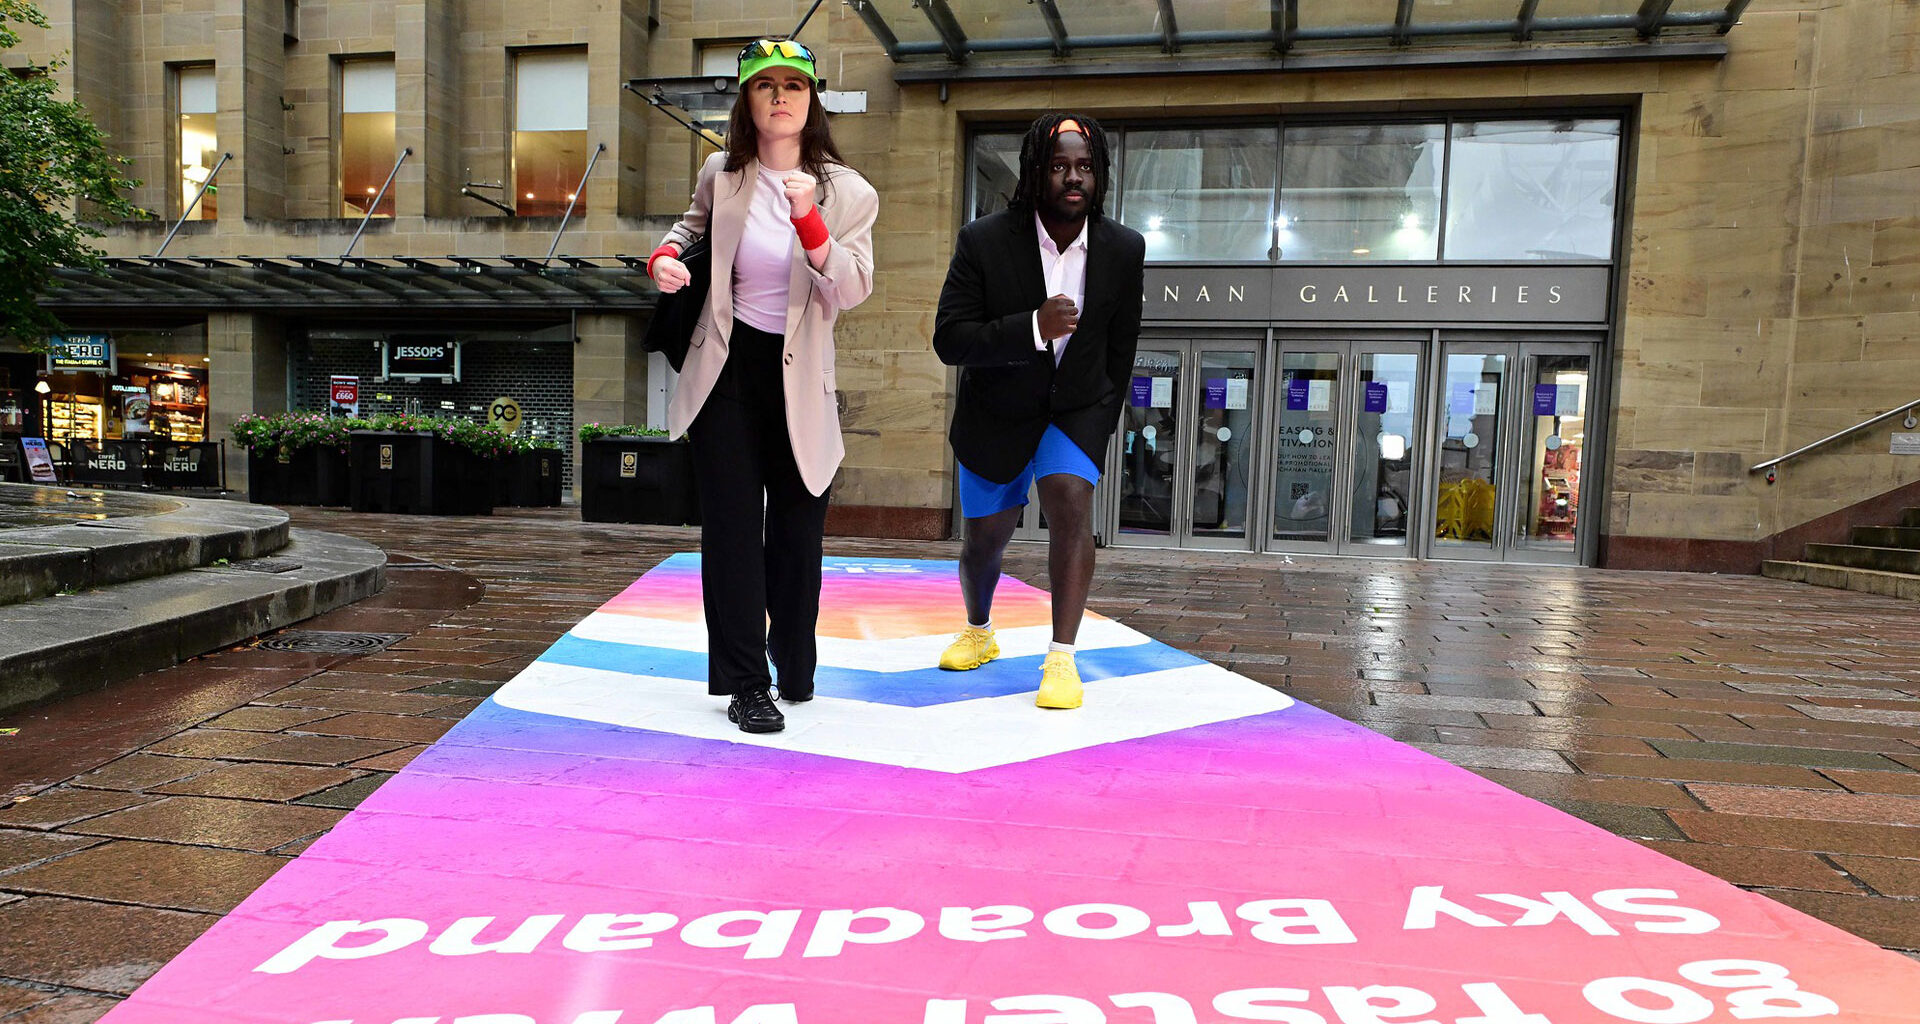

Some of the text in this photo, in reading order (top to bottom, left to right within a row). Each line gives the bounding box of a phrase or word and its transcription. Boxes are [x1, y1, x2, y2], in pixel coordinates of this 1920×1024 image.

[1142, 285, 1562, 304] NAN GALLERIES
[394, 346, 444, 360] JESSOPS
[88, 460, 126, 470] NERO
[163, 462, 198, 472] NERO
[253, 886, 1720, 974] Sky Broadband
[1583, 960, 1838, 1024] go
